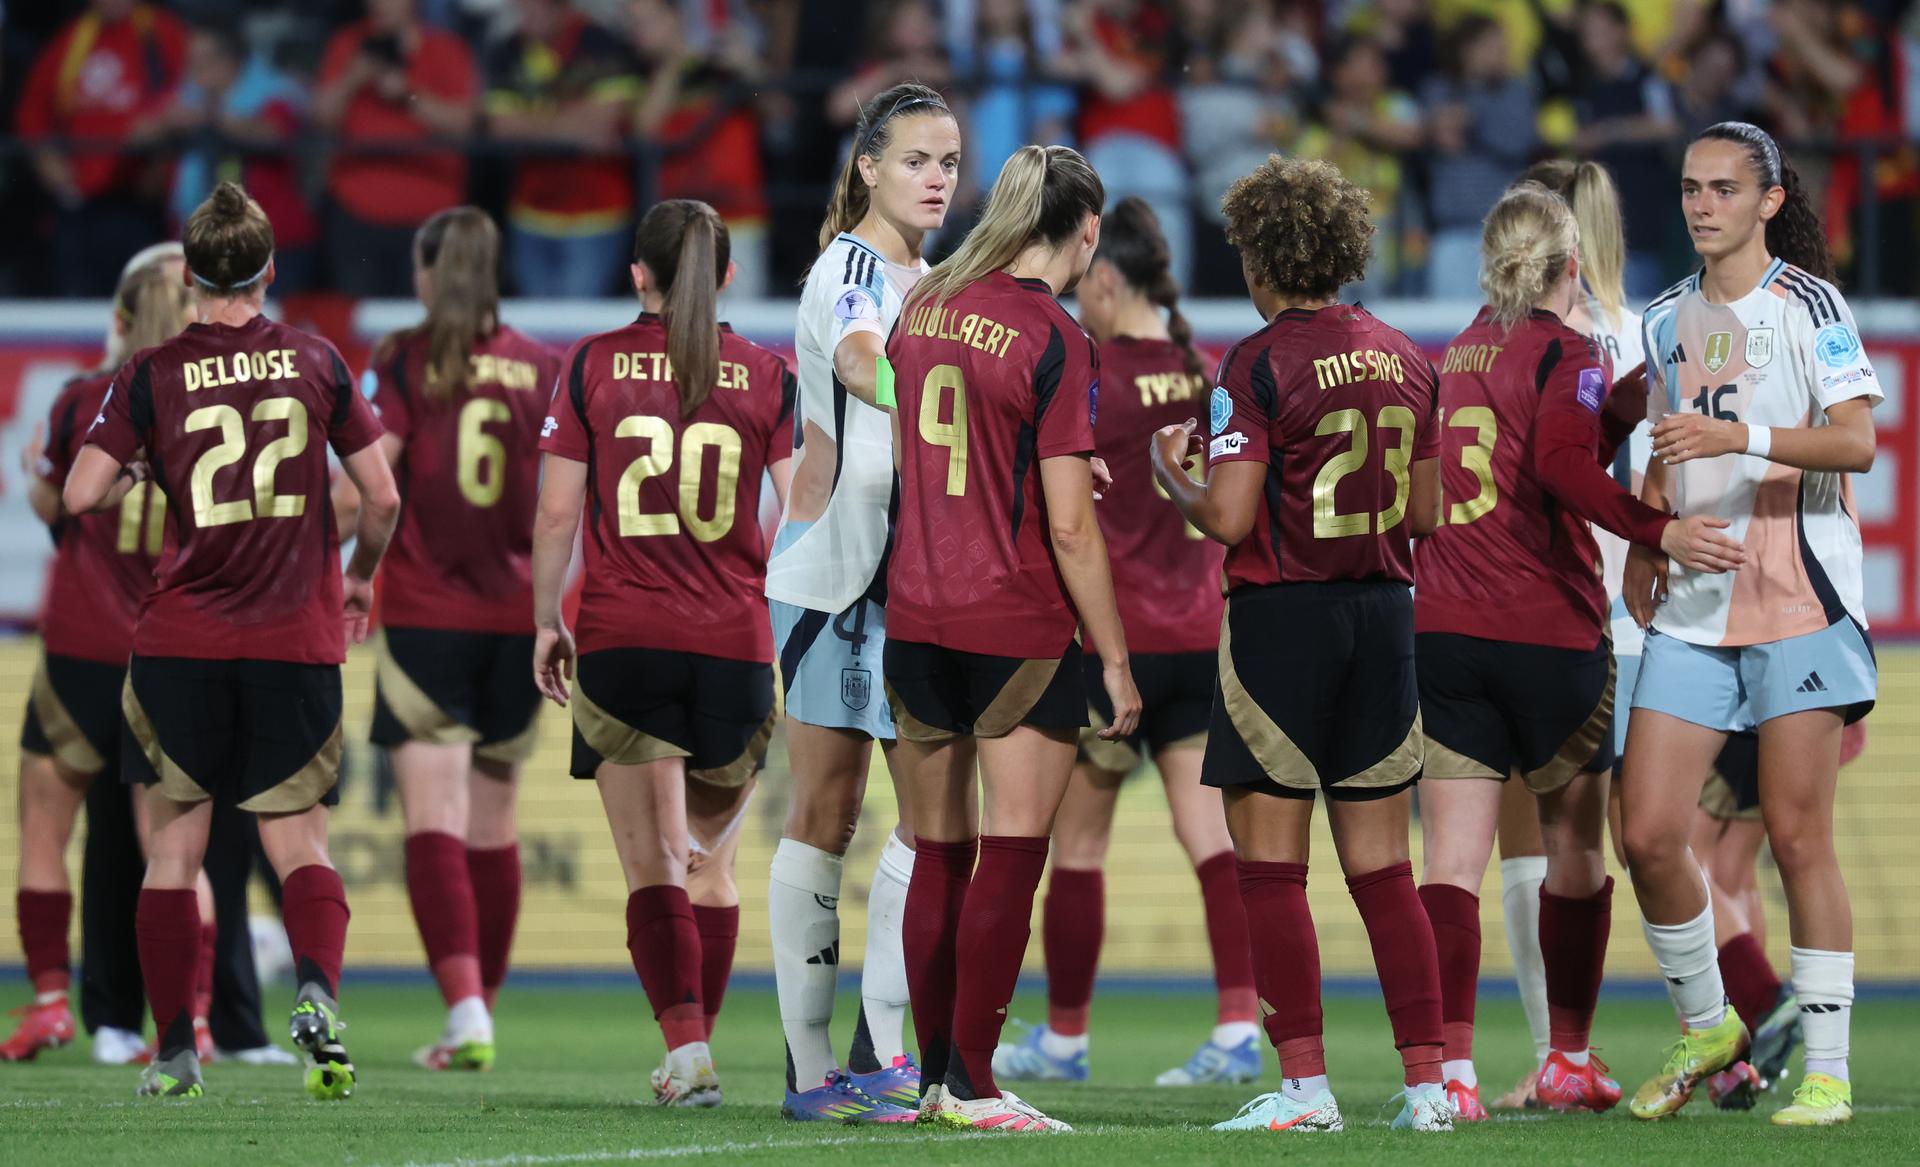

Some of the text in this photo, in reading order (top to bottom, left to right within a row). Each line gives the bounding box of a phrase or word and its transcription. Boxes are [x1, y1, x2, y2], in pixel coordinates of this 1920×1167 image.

[183, 349, 300, 392] DELOOSE
[613, 352, 750, 391] DETER
[908, 306, 1020, 359] WULLAERT
[1313, 349, 1404, 390] MISSIPO
[1441, 344, 1503, 374] DHONT
[184, 396, 309, 528] 22
[457, 397, 512, 508] 6
[918, 364, 969, 497] 9
[1313, 405, 1417, 539] 23
[1436, 406, 1499, 527] 3
[614, 415, 742, 543] 20
[832, 596, 869, 657] 4
